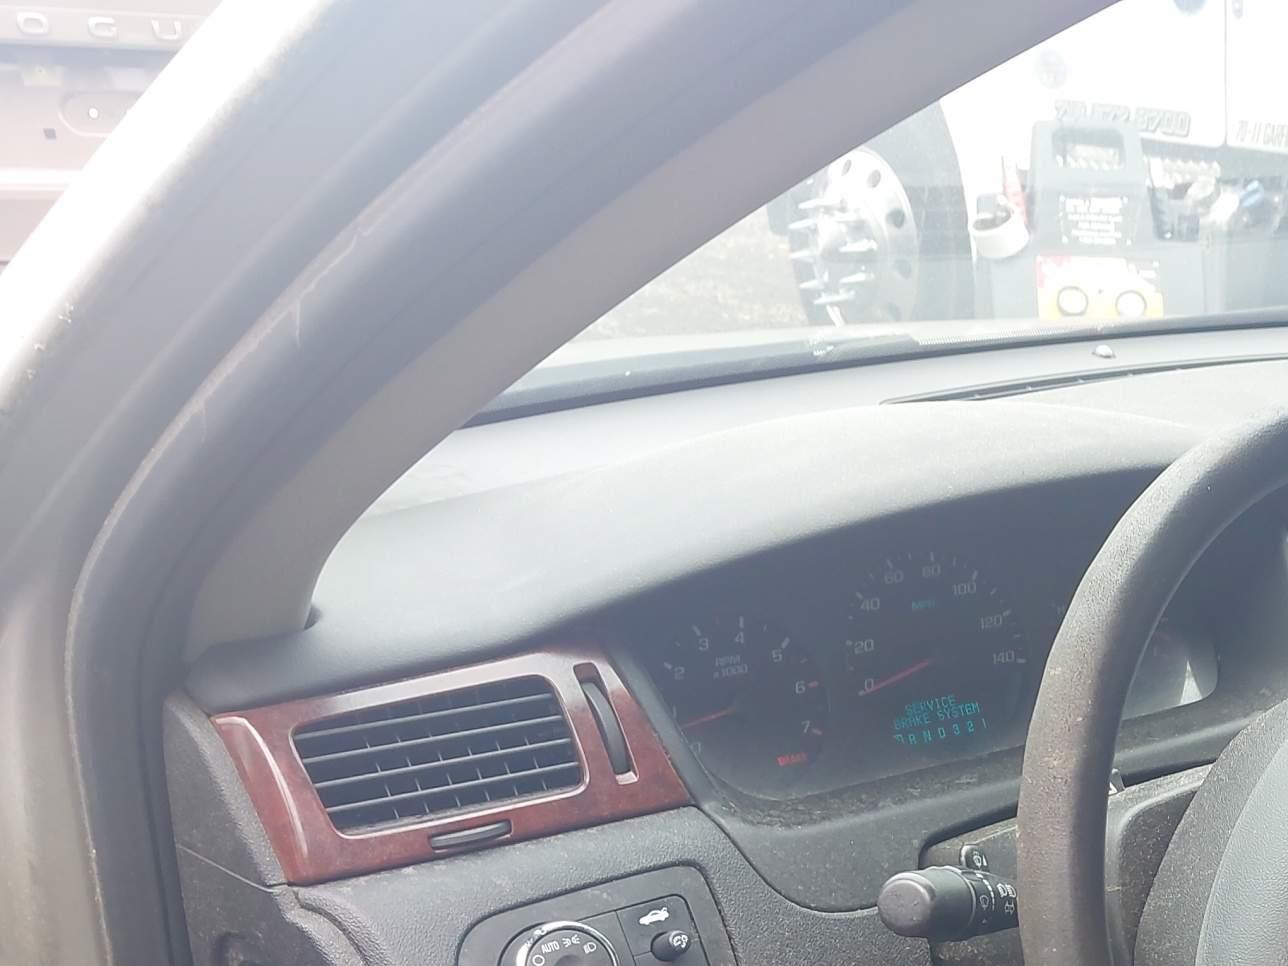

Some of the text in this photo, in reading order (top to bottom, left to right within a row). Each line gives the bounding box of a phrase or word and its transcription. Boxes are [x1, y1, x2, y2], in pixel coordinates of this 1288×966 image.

[952, 580, 977, 597] 100
[860, 597, 880, 612] 40
[978, 613, 1003, 630] 120
[698, 637, 710, 652] 3
[735, 631, 745, 645] 4
[853, 638, 875, 655] 20
[771, 649, 783, 663] 5
[993, 649, 1015, 666] 140
[795, 681, 807, 695] 6
[905, 694, 956, 717] SERVICE
[937, 701, 981, 721] SYSTEM
[801, 720, 811, 734] 7
[541, 940, 560, 954] AUTO
